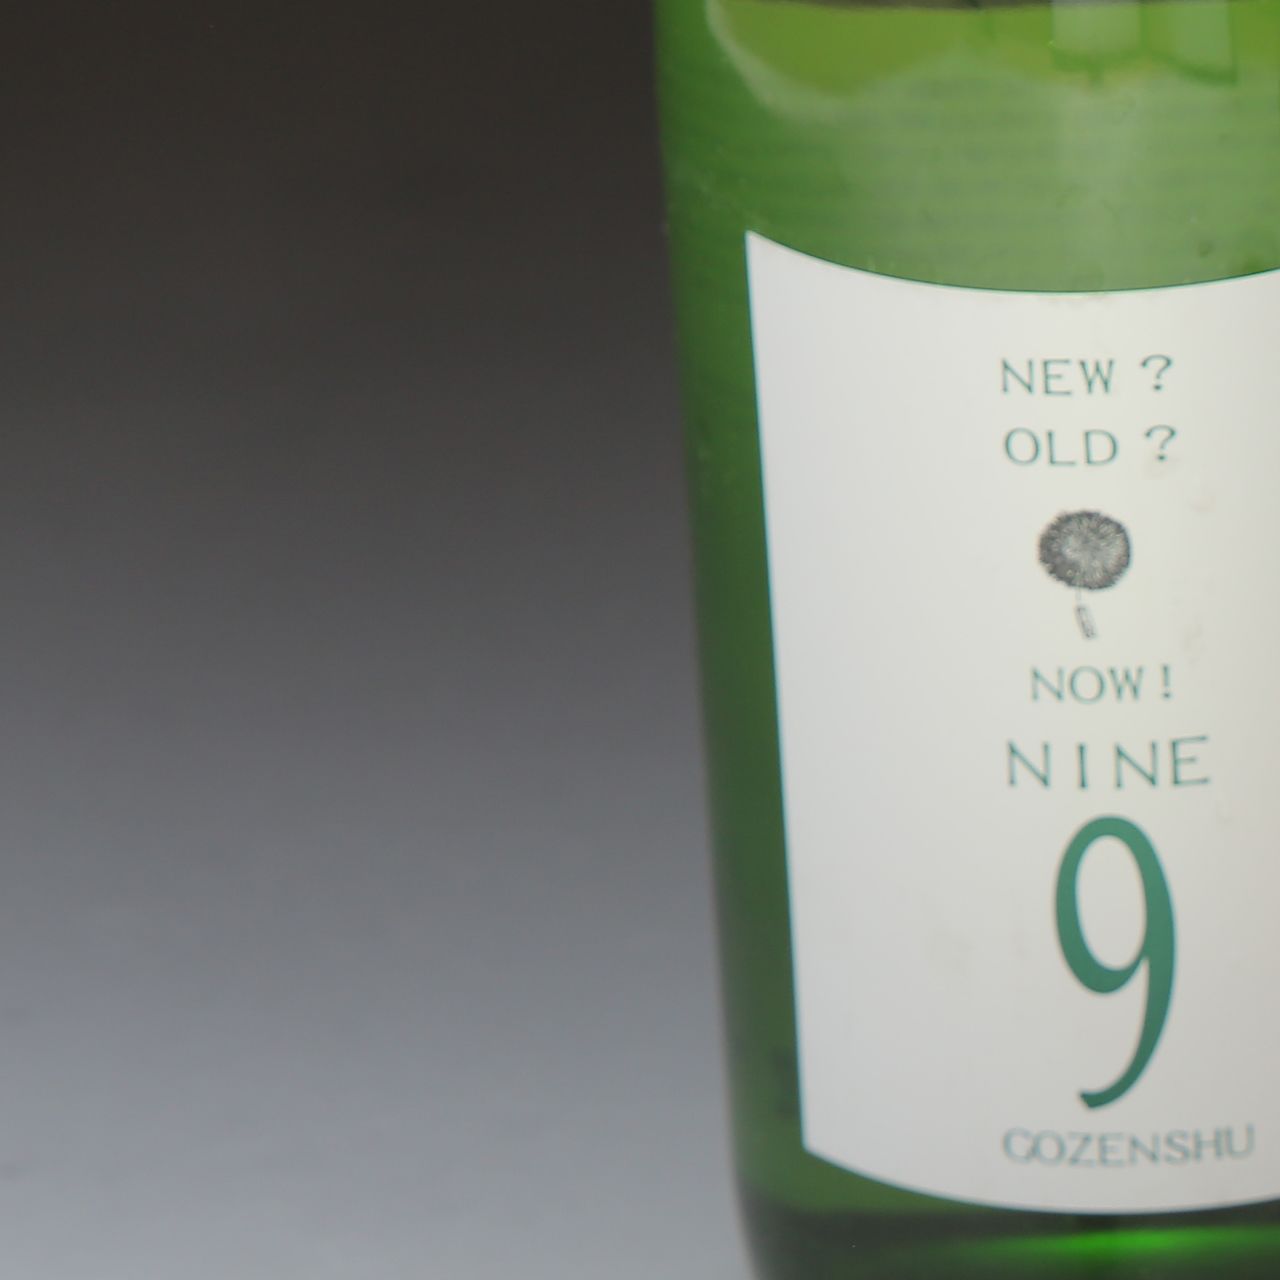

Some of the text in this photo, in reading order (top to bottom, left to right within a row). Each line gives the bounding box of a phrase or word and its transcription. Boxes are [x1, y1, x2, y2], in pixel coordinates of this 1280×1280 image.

[1001, 358, 1113, 395] NEW
[1004, 427, 1119, 466] OLD
[1030, 662, 1173, 704] NOW!
[1006, 735, 1212, 790] NINE
[1054, 813, 1177, 1110] 9
[1002, 1124, 1256, 1166] GOZENSHU
